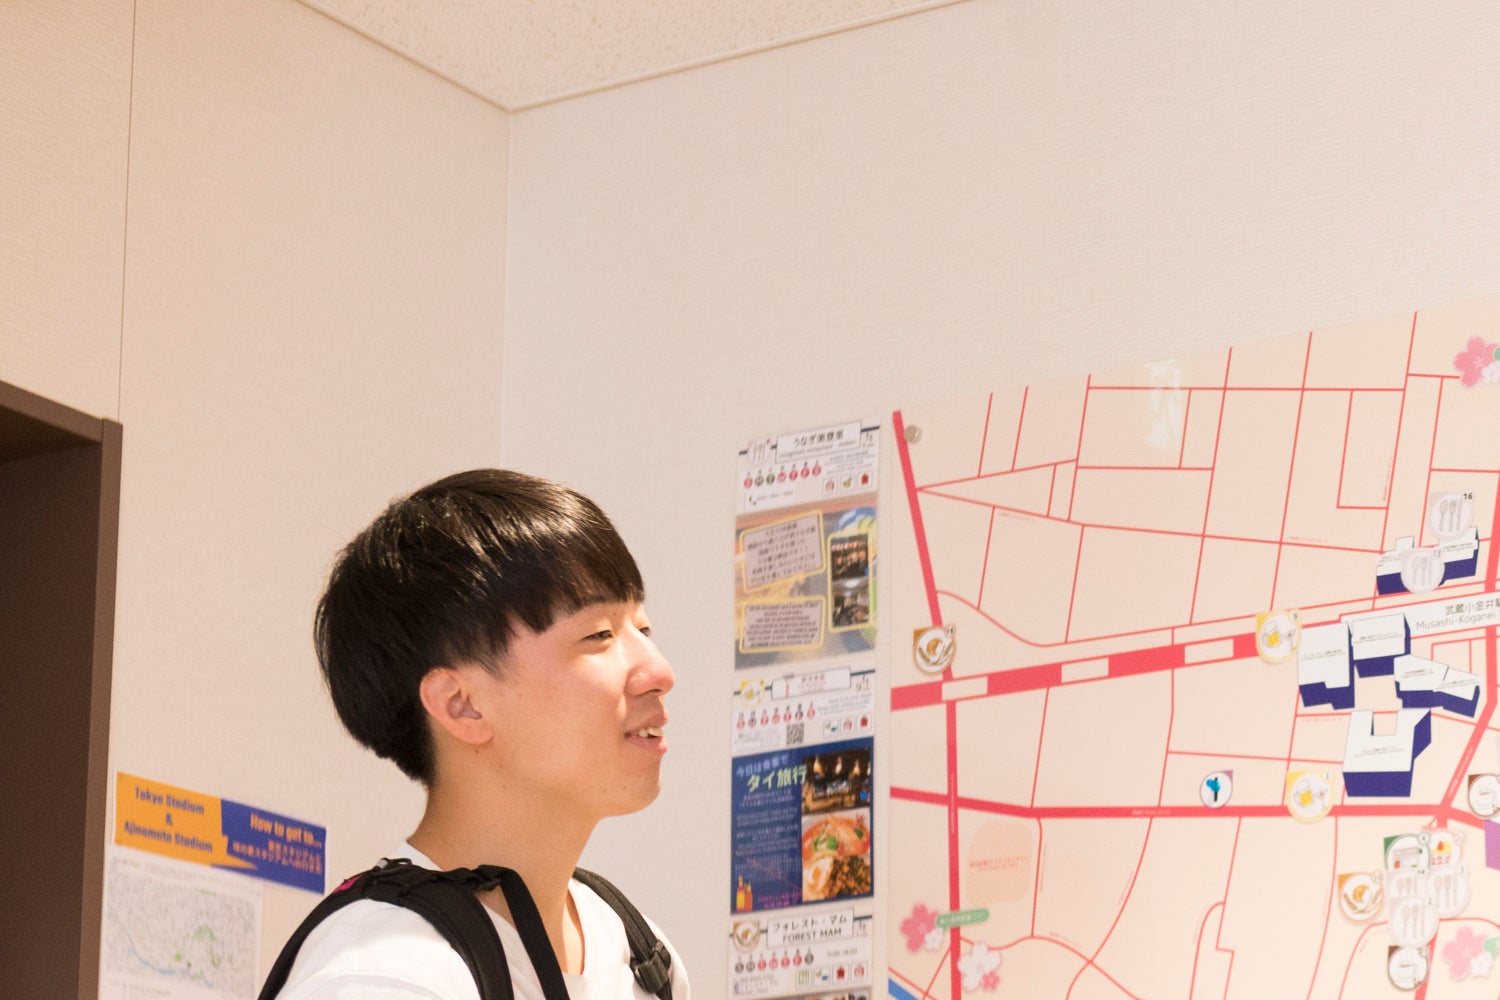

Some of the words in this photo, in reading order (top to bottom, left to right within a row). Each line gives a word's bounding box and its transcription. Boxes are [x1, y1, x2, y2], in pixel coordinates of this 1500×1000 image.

[1463, 492, 1473, 500] 16
[1416, 611, 1497, 630] Musashi-Koganei
[747, 763, 808, 793] タイ旅行
[135, 786, 163, 805] Tokyo
[166, 795, 205, 815] Stadium
[165, 813, 173, 826] &
[250, 814, 273, 834] How
[274, 823, 285, 837] to
[286, 826, 302, 841] get
[124, 820, 172, 843] Ajinomoto
[174, 833, 213, 853] Stadium
[782, 929, 817, 943] FOREST
[820, 928, 843, 938] MAM
